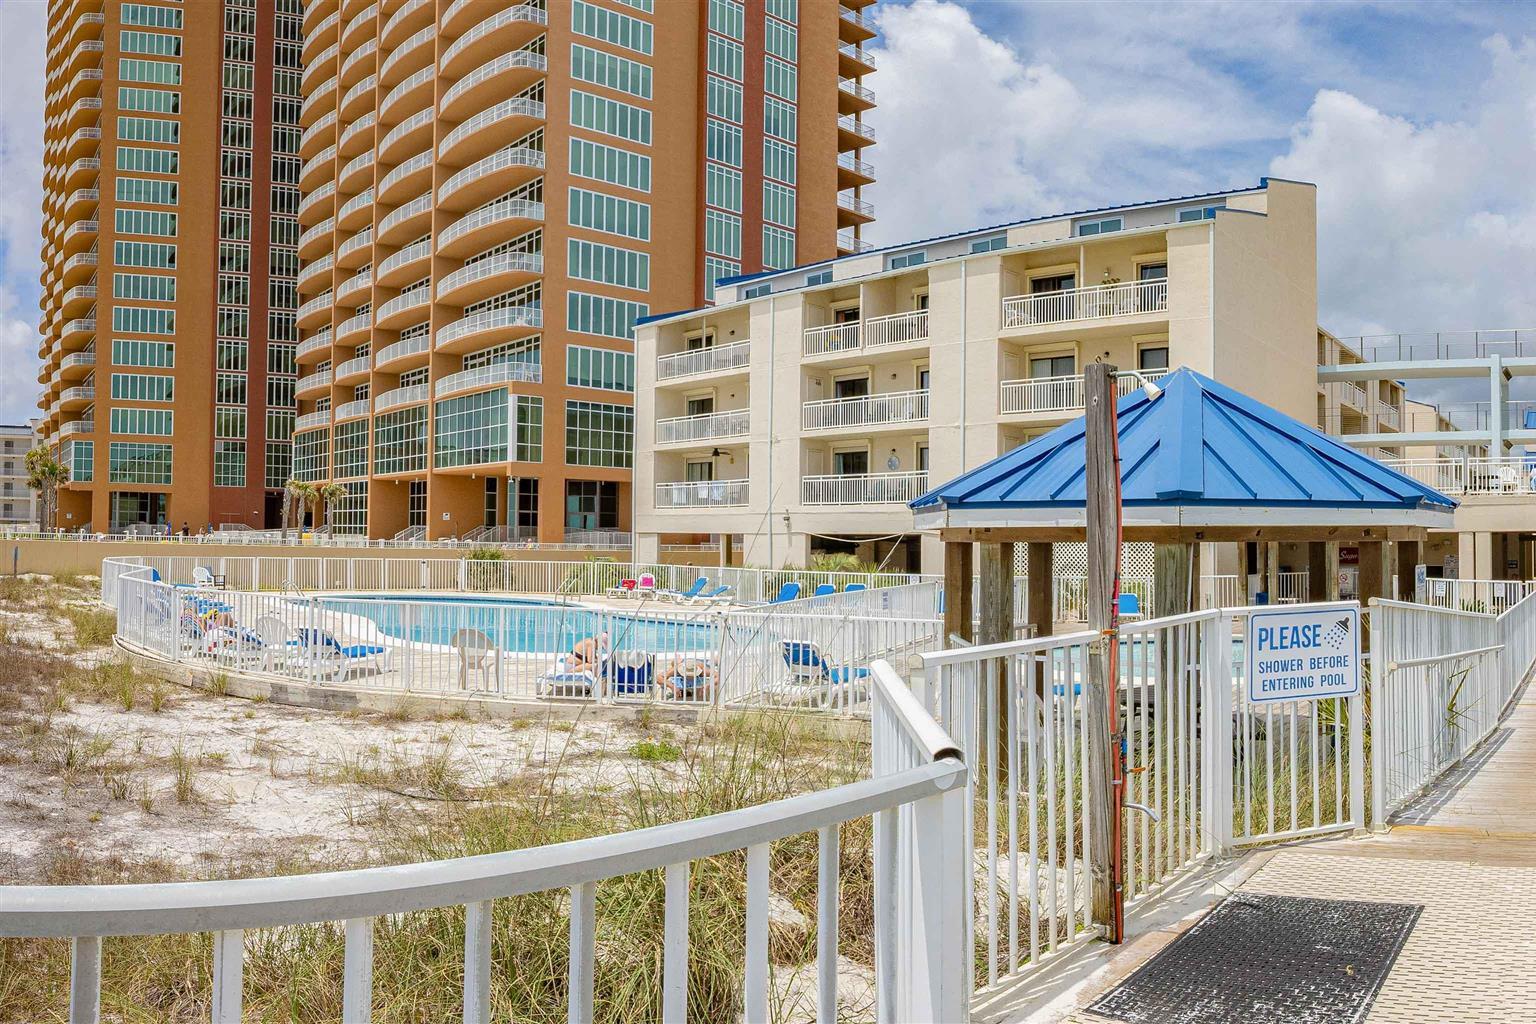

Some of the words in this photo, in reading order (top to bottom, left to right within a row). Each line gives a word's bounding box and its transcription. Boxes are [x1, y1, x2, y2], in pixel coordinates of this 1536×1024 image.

[1258, 624, 1322, 651] PLEASE
[1258, 658, 1303, 674] SHOWER
[1310, 655, 1349, 670] BEFORE
[1262, 675, 1314, 691] ENTERING
[1321, 673, 1347, 687] POOL
